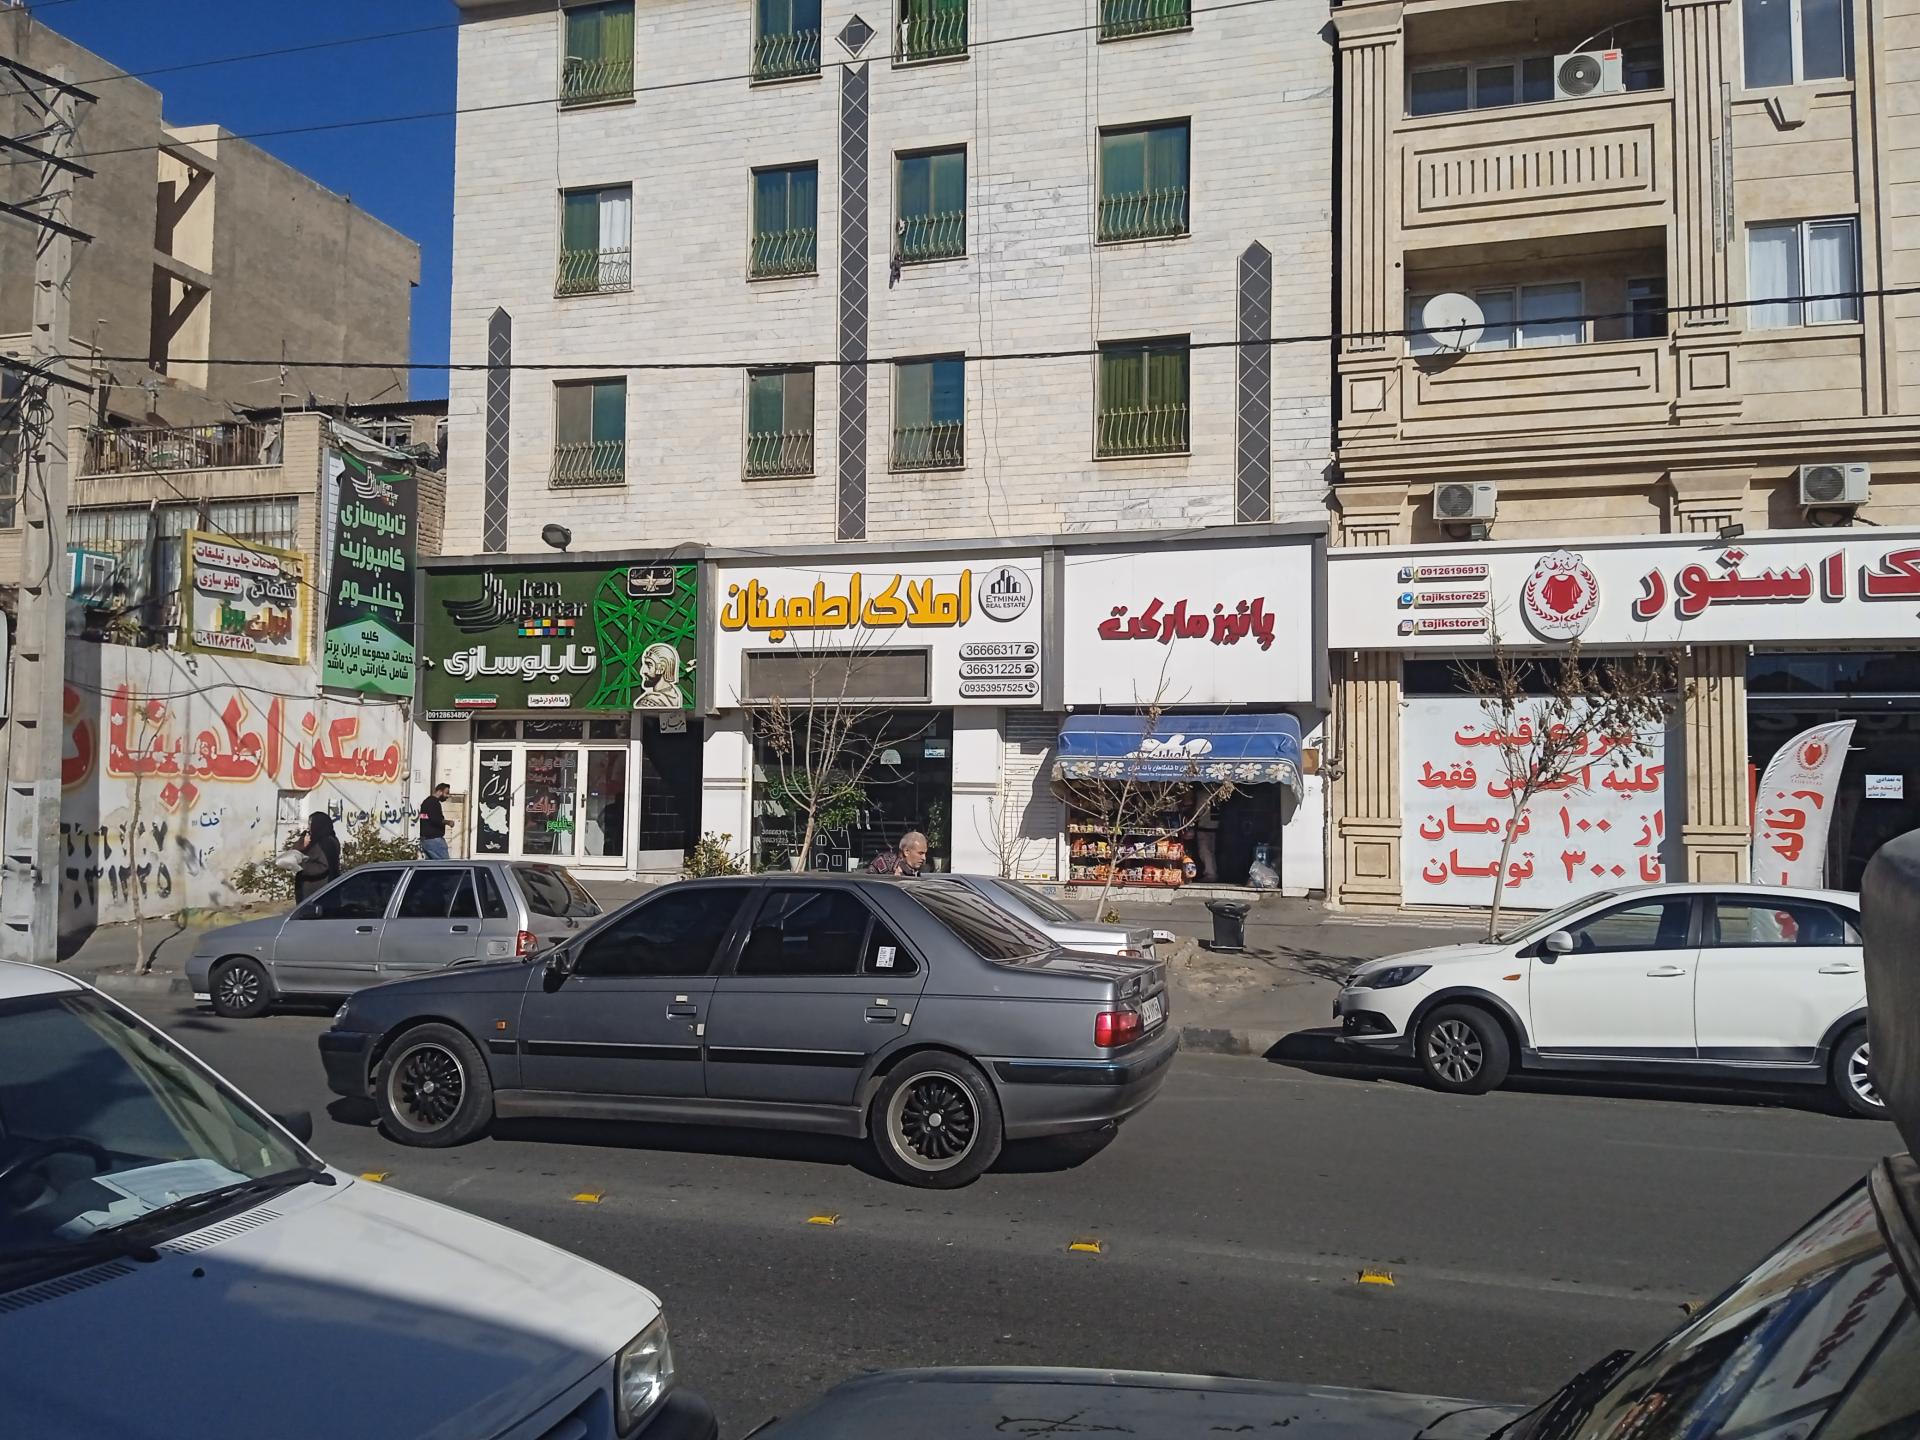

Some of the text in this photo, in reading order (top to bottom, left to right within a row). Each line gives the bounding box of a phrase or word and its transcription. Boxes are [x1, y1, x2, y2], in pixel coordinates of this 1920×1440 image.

[341, 501, 406, 539] تابلوسازی
[196, 545, 225, 562] تبلیغات
[233, 553, 250, 569] چاپ
[340, 531, 405, 578] کامپوزیت
[199, 573, 240, 592] تابلو سازی
[1420, 567, 1486, 576] 09126196913
[1636, 546, 1847, 618] استور
[522, 579, 561, 597] Iran
[1421, 591, 1486, 602] tajikstore25
[339, 580, 404, 622] چنلیوم
[521, 600, 588, 617] Bartar
[720, 569, 972, 643] املاک اطمینان
[1098, 597, 1210, 646] مارکت
[1422, 618, 1486, 629] tajikstore1
[361, 631, 379, 644] کلیه
[324, 640, 414, 665] خدمات مجموعه ایران برتر
[966, 645, 1021, 655] 36666317
[327, 655, 344, 673] باشد
[346, 664, 358, 674] می
[389, 665, 408, 680] شامل
[443, 644, 597, 682] تابلوسازی
[966, 664, 1022, 675] 36631225
[964, 684, 1024, 693] 09353957525
[428, 711, 470, 720] 09128634890
[1454, 716, 1533, 748] قیمت
[292, 711, 402, 790] مسکن
[1417, 759, 1477, 789] فقط
[1602, 763, 1665, 800] کلیه
[482, 773, 509, 801] ایران
[1419, 804, 1664, 847] از ۱۰۰ تومان
[1762, 790, 1825, 862] زنانه
[1422, 847, 1662, 889] تا ۳۰۰ تومان
